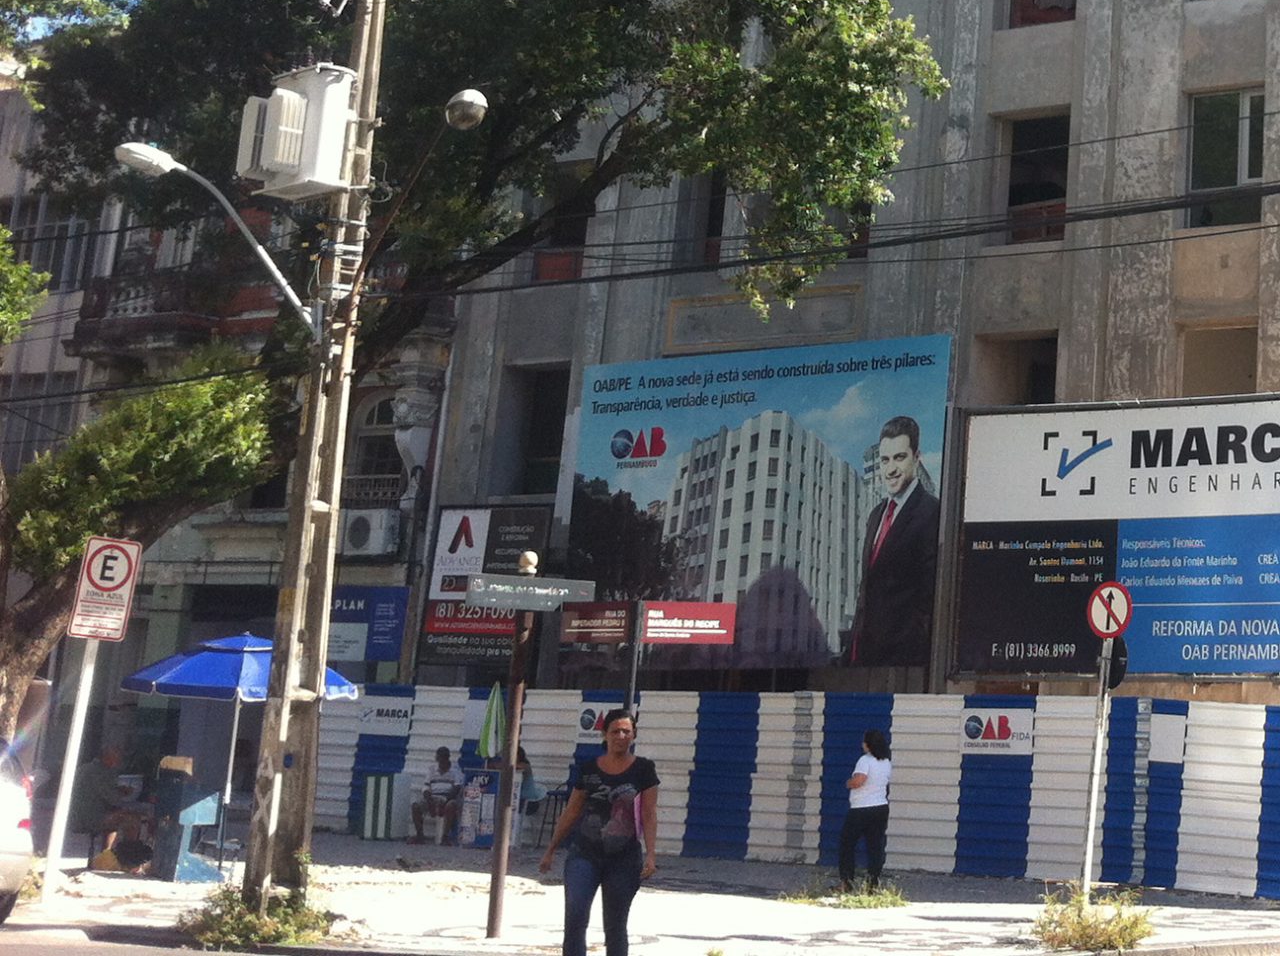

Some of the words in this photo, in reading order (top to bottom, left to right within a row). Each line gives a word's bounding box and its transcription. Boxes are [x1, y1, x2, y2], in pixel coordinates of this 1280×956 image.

[593, 376, 631, 393] OAB/PE
[638, 376, 646, 389] A
[648, 376, 674, 388] nova
[676, 371, 701, 386] sede
[703, 370, 714, 388] já
[716, 367, 739, 383] está
[742, 364, 774, 381] sendo
[777, 360, 835, 378] construída
[837, 357, 868, 373] sobre
[871, 356, 892, 370] três
[894, 352, 936, 372] pilares:
[592, 398, 663, 416] Transparência,
[665, 392, 708, 408] verdade
[711, 395, 718, 405] e
[719, 389, 757, 408] justiça.
[610, 426, 667, 459] OAB
[616, 459, 658, 470] PERNAMBUCO
[972, 541, 994, 550] MARCA
[1121, 557, 1138, 568] João
[1139, 556, 1170, 568] Eduardo
[1172, 556, 1182, 567] da
[1206, 554, 1238, 566] Marinho
[1257, 553, 1279, 565] CREA
[99, 554, 119, 582] E
[1121, 575, 1143, 587] Carlos
[1145, 575, 1176, 587] Eduardo
[1211, 574, 1222, 585] de
[1223, 573, 1244, 585] Paiva
[1258, 572, 1280, 584] CREA
[330, 599, 365, 611] PLAN
[648, 610, 664, 618] RUA
[1152, 619, 1214, 637] REFORMA
[1218, 620, 1237, 636] DA
[1241, 619, 1280, 636] NOVA
[1004, 642, 1024, 661] (81)
[1182, 643, 1209, 661] OAB
[376, 708, 408, 719] MARCA
[964, 715, 1011, 740] OAB
